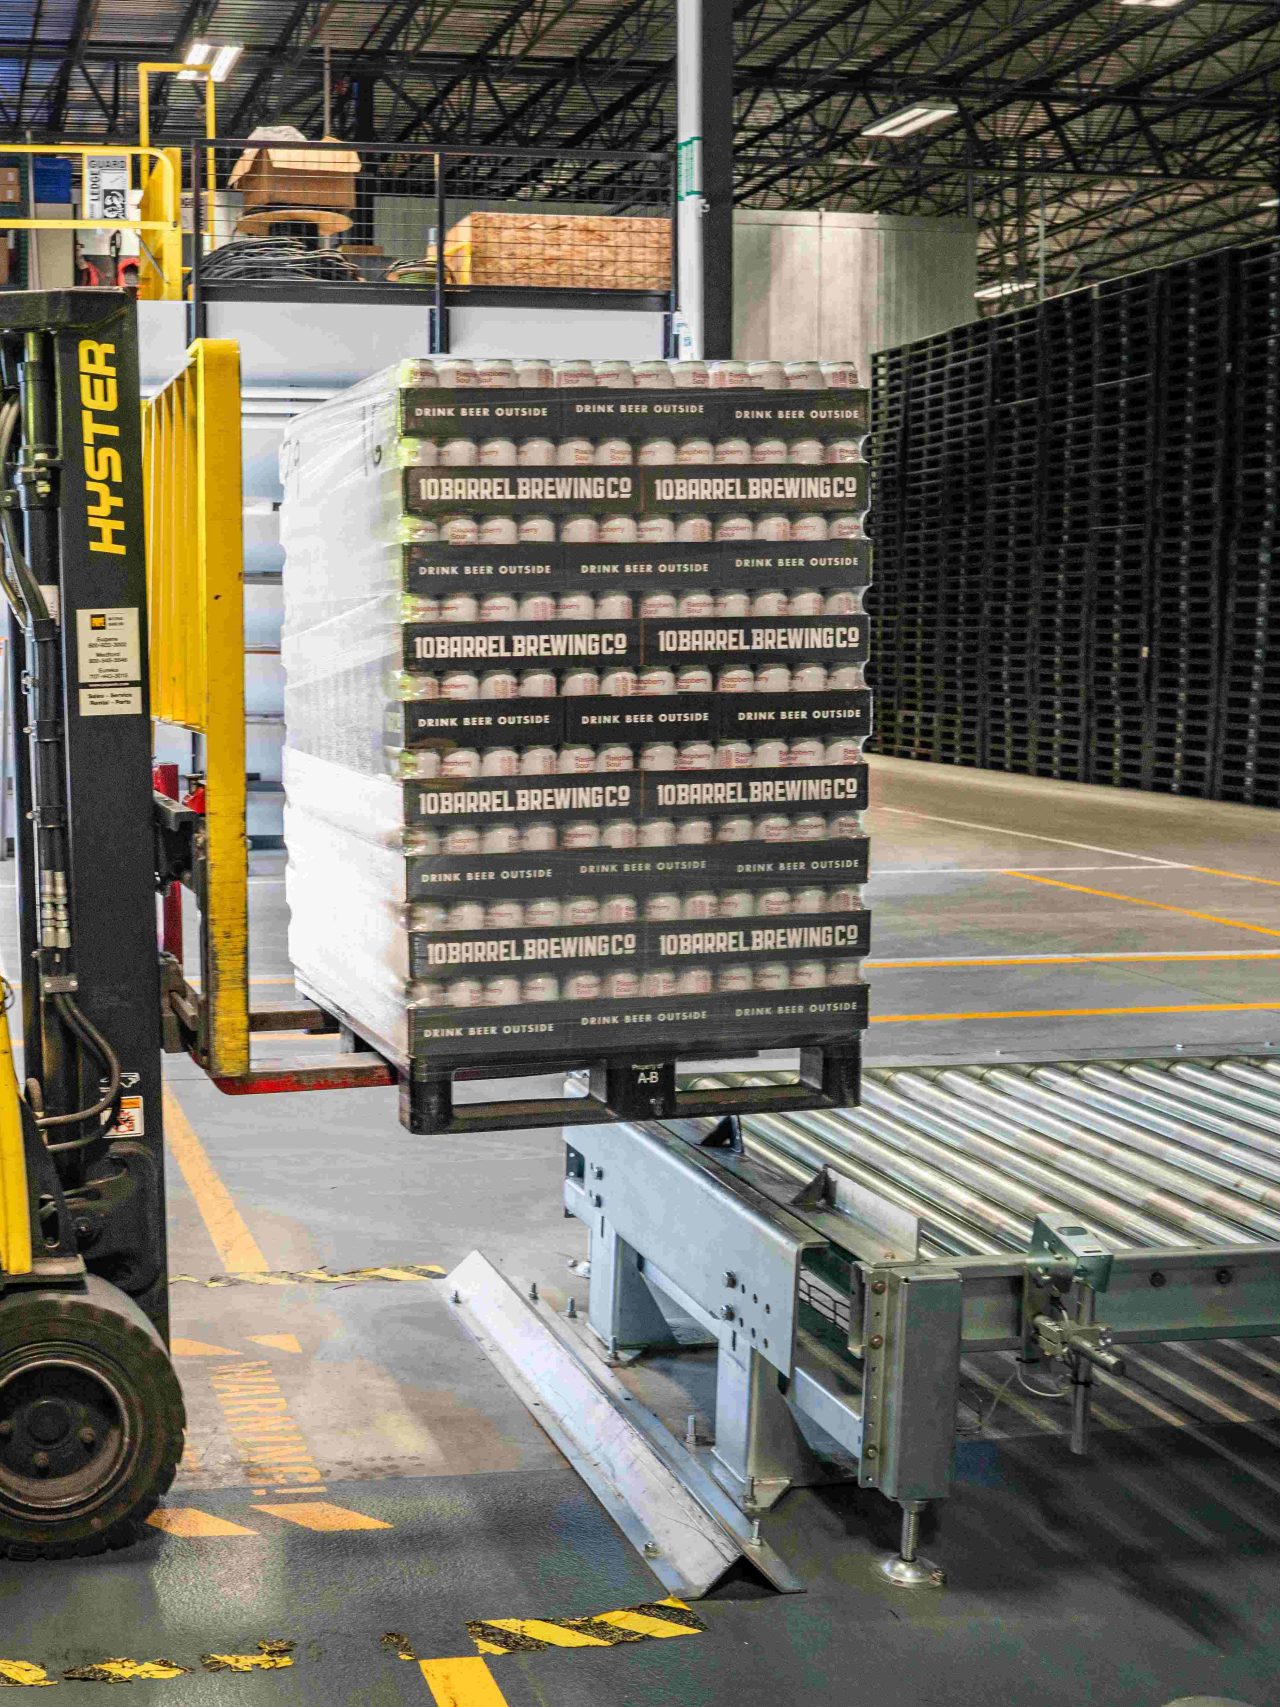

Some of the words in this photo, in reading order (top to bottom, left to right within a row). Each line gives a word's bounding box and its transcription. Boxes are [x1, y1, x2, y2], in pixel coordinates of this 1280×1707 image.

[89, 170, 101, 201] LEDGE
[414, 407, 456, 417] DRINK
[460, 407, 490, 417] BEER
[494, 407, 548, 417] OUTSIDE
[575, 404, 615, 413] DRINK
[619, 404, 648, 413] BEER
[653, 404, 705, 414] OUTSIDE
[734, 410, 773, 419] DRINK
[777, 409, 806, 419] BEER
[809, 409, 860, 419] OUTSIDE
[78, 340, 126, 555] HYSTER
[580, 564, 620, 574] DRINK
[624, 564, 654, 573] BEER
[657, 563, 709, 573] OUTSIDE
[735, 558, 773, 568] DRINK
[777, 558, 805, 567] BEER
[809, 557, 859, 567] OUTSIDE
[418, 565, 460, 576] DRINK
[463, 565, 494, 575] BEER
[498, 565, 551, 575] OUTSIDE
[417, 717, 459, 728] DRINK
[462, 716, 493, 726] BEER
[496, 714, 550, 725] OUTSIDE
[581, 714, 621, 725] DRINK
[624, 713, 654, 724] BEER
[658, 712, 709, 723] OUTSIDE
[737, 711, 776, 721] DRINK
[779, 710, 808, 720] BEER
[811, 709, 862, 719] OUTSIDE
[579, 864, 618, 874] DRINK
[622, 862, 652, 872] BEER
[655, 860, 707, 871] OUTSIDE
[736, 863, 774, 873] DRINK
[778, 861, 806, 872] BEER
[810, 859, 860, 870] OUTSIDE
[419, 872, 461, 883] DRINK
[466, 871, 496, 881] BEER
[500, 868, 553, 880] OUTSIDE
[734, 1006, 774, 1017] DRINK
[776, 1004, 805, 1015] BEER
[808, 1001, 857, 1013] OUTSIDE
[580, 1015, 620, 1026] DRINK
[623, 1013, 653, 1024] BEER
[656, 1010, 707, 1022] OUTSIDE
[423, 1027, 464, 1038] DRINK
[467, 1025, 498, 1036] BEER
[502, 1023, 555, 1034] OUTSIDE
[637, 1071, 659, 1084] A-B
